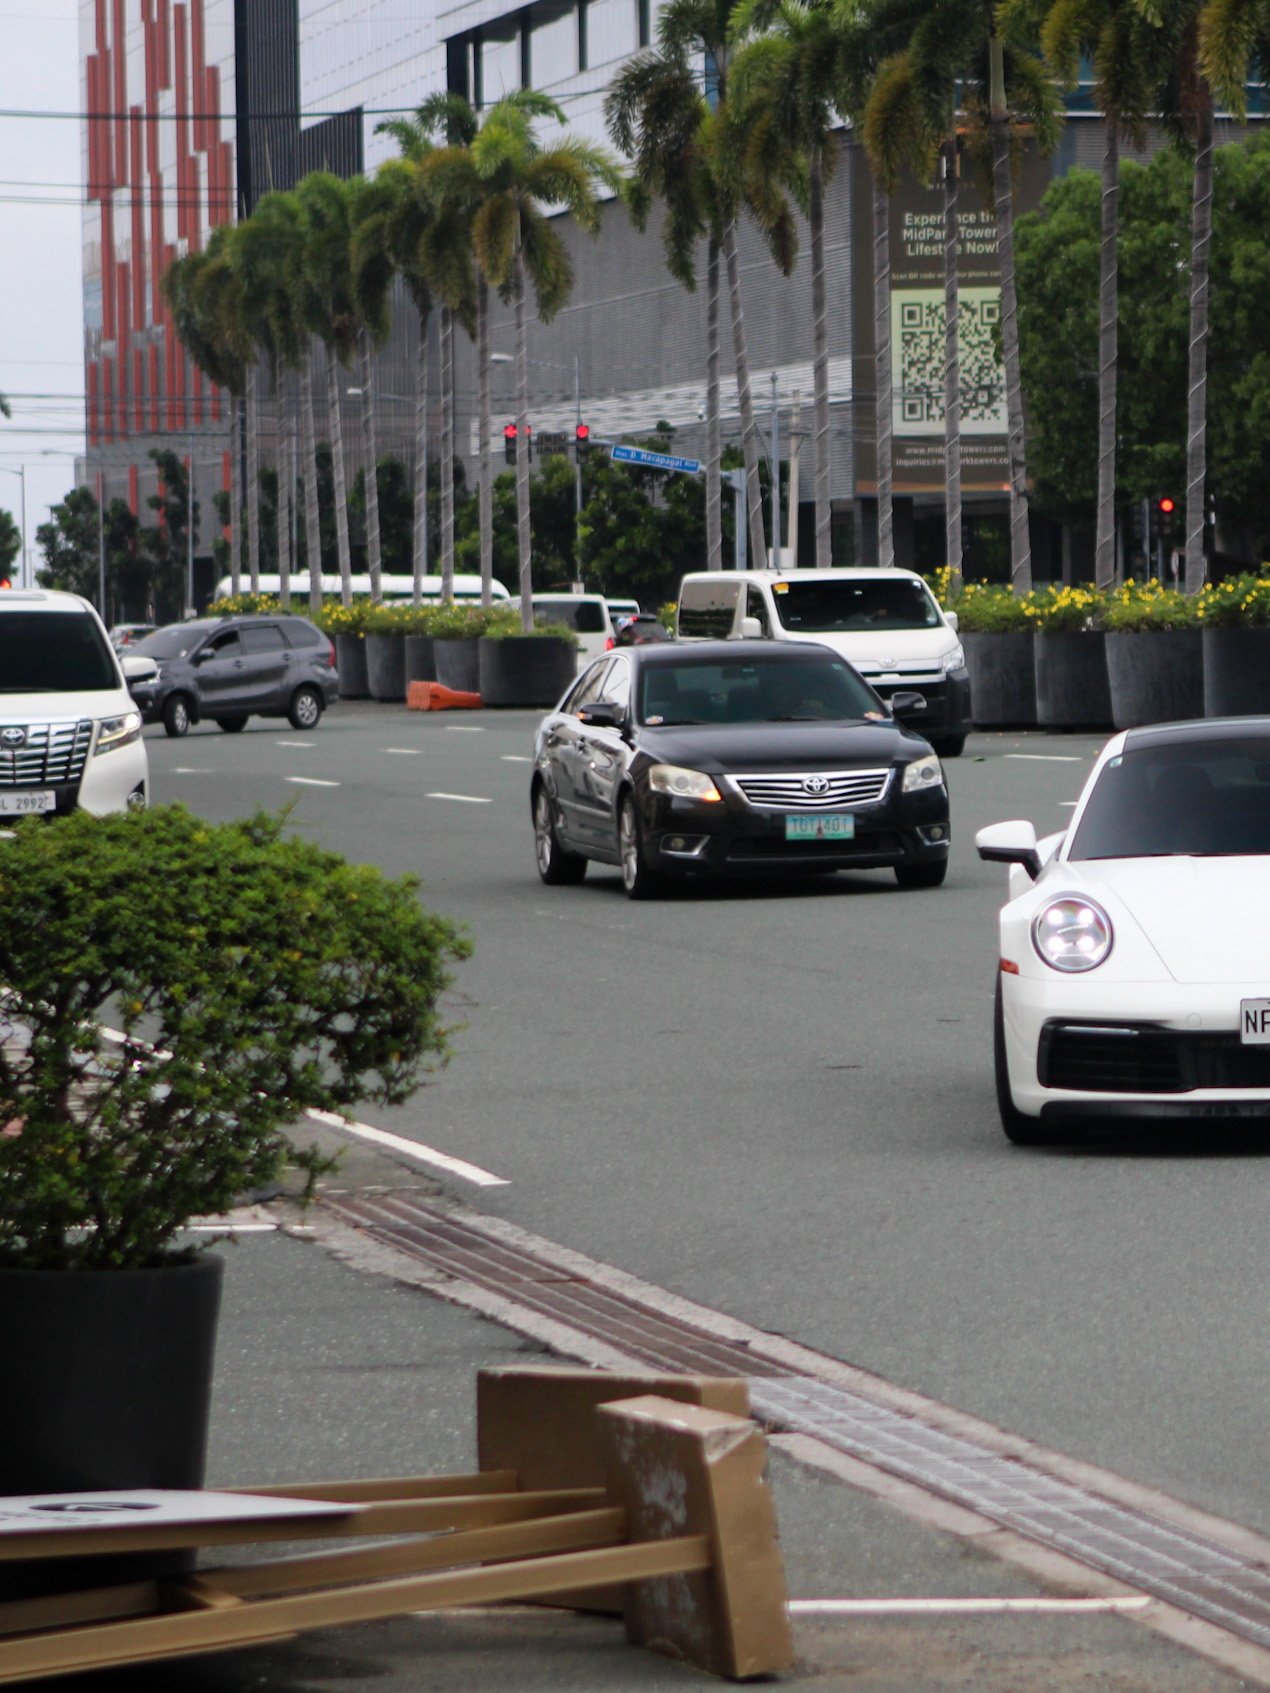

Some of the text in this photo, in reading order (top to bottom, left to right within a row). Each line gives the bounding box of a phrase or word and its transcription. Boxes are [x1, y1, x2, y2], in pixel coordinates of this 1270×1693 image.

[905, 212, 977, 227] Experince
[903, 228, 946, 241] MidPar
[907, 241, 1000, 256] Lifeste Now!
